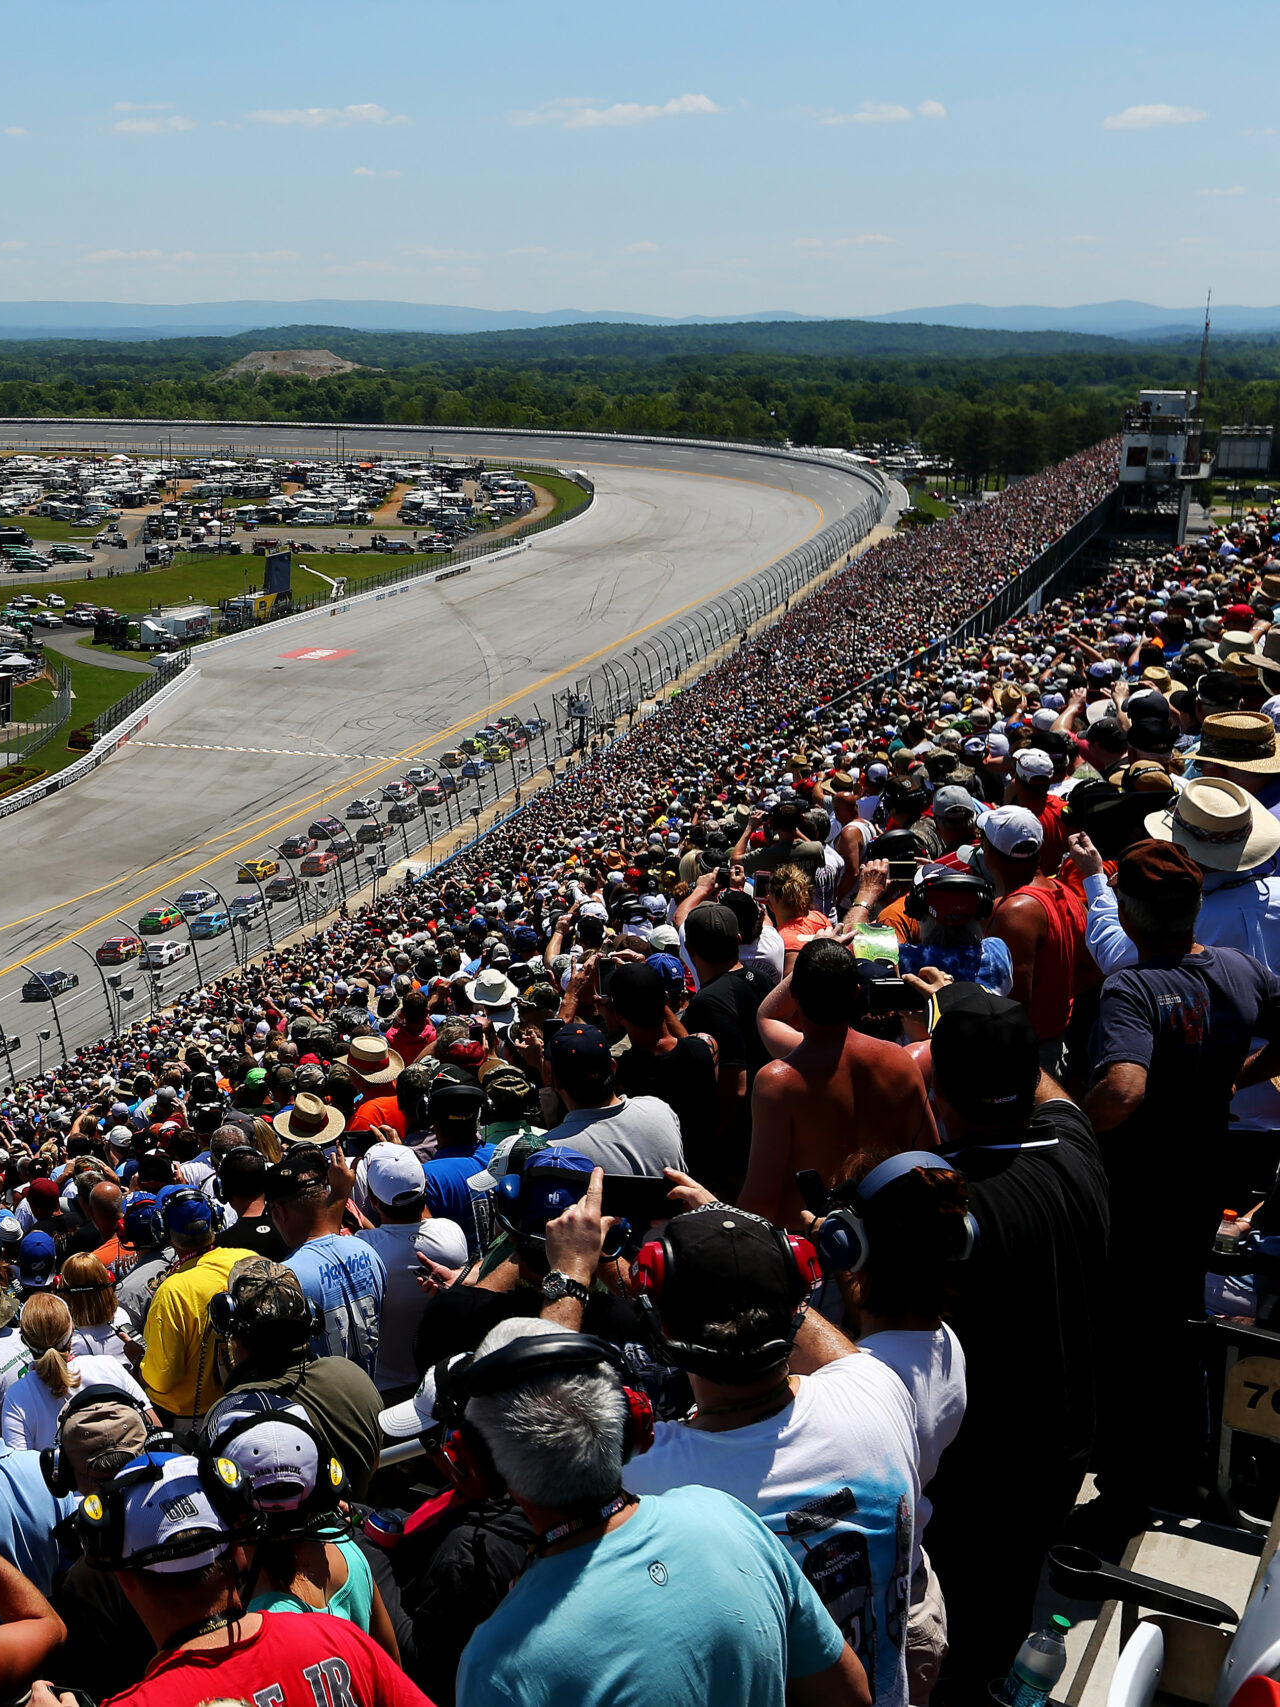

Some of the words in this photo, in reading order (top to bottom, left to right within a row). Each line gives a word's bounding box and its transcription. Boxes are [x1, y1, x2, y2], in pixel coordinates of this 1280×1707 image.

[318, 1250, 372, 1289] Hendrick
[273, 1464, 302, 1477] ANNUAL
[159, 1494, 200, 1522] 88
[302, 1657, 359, 1707] JR
